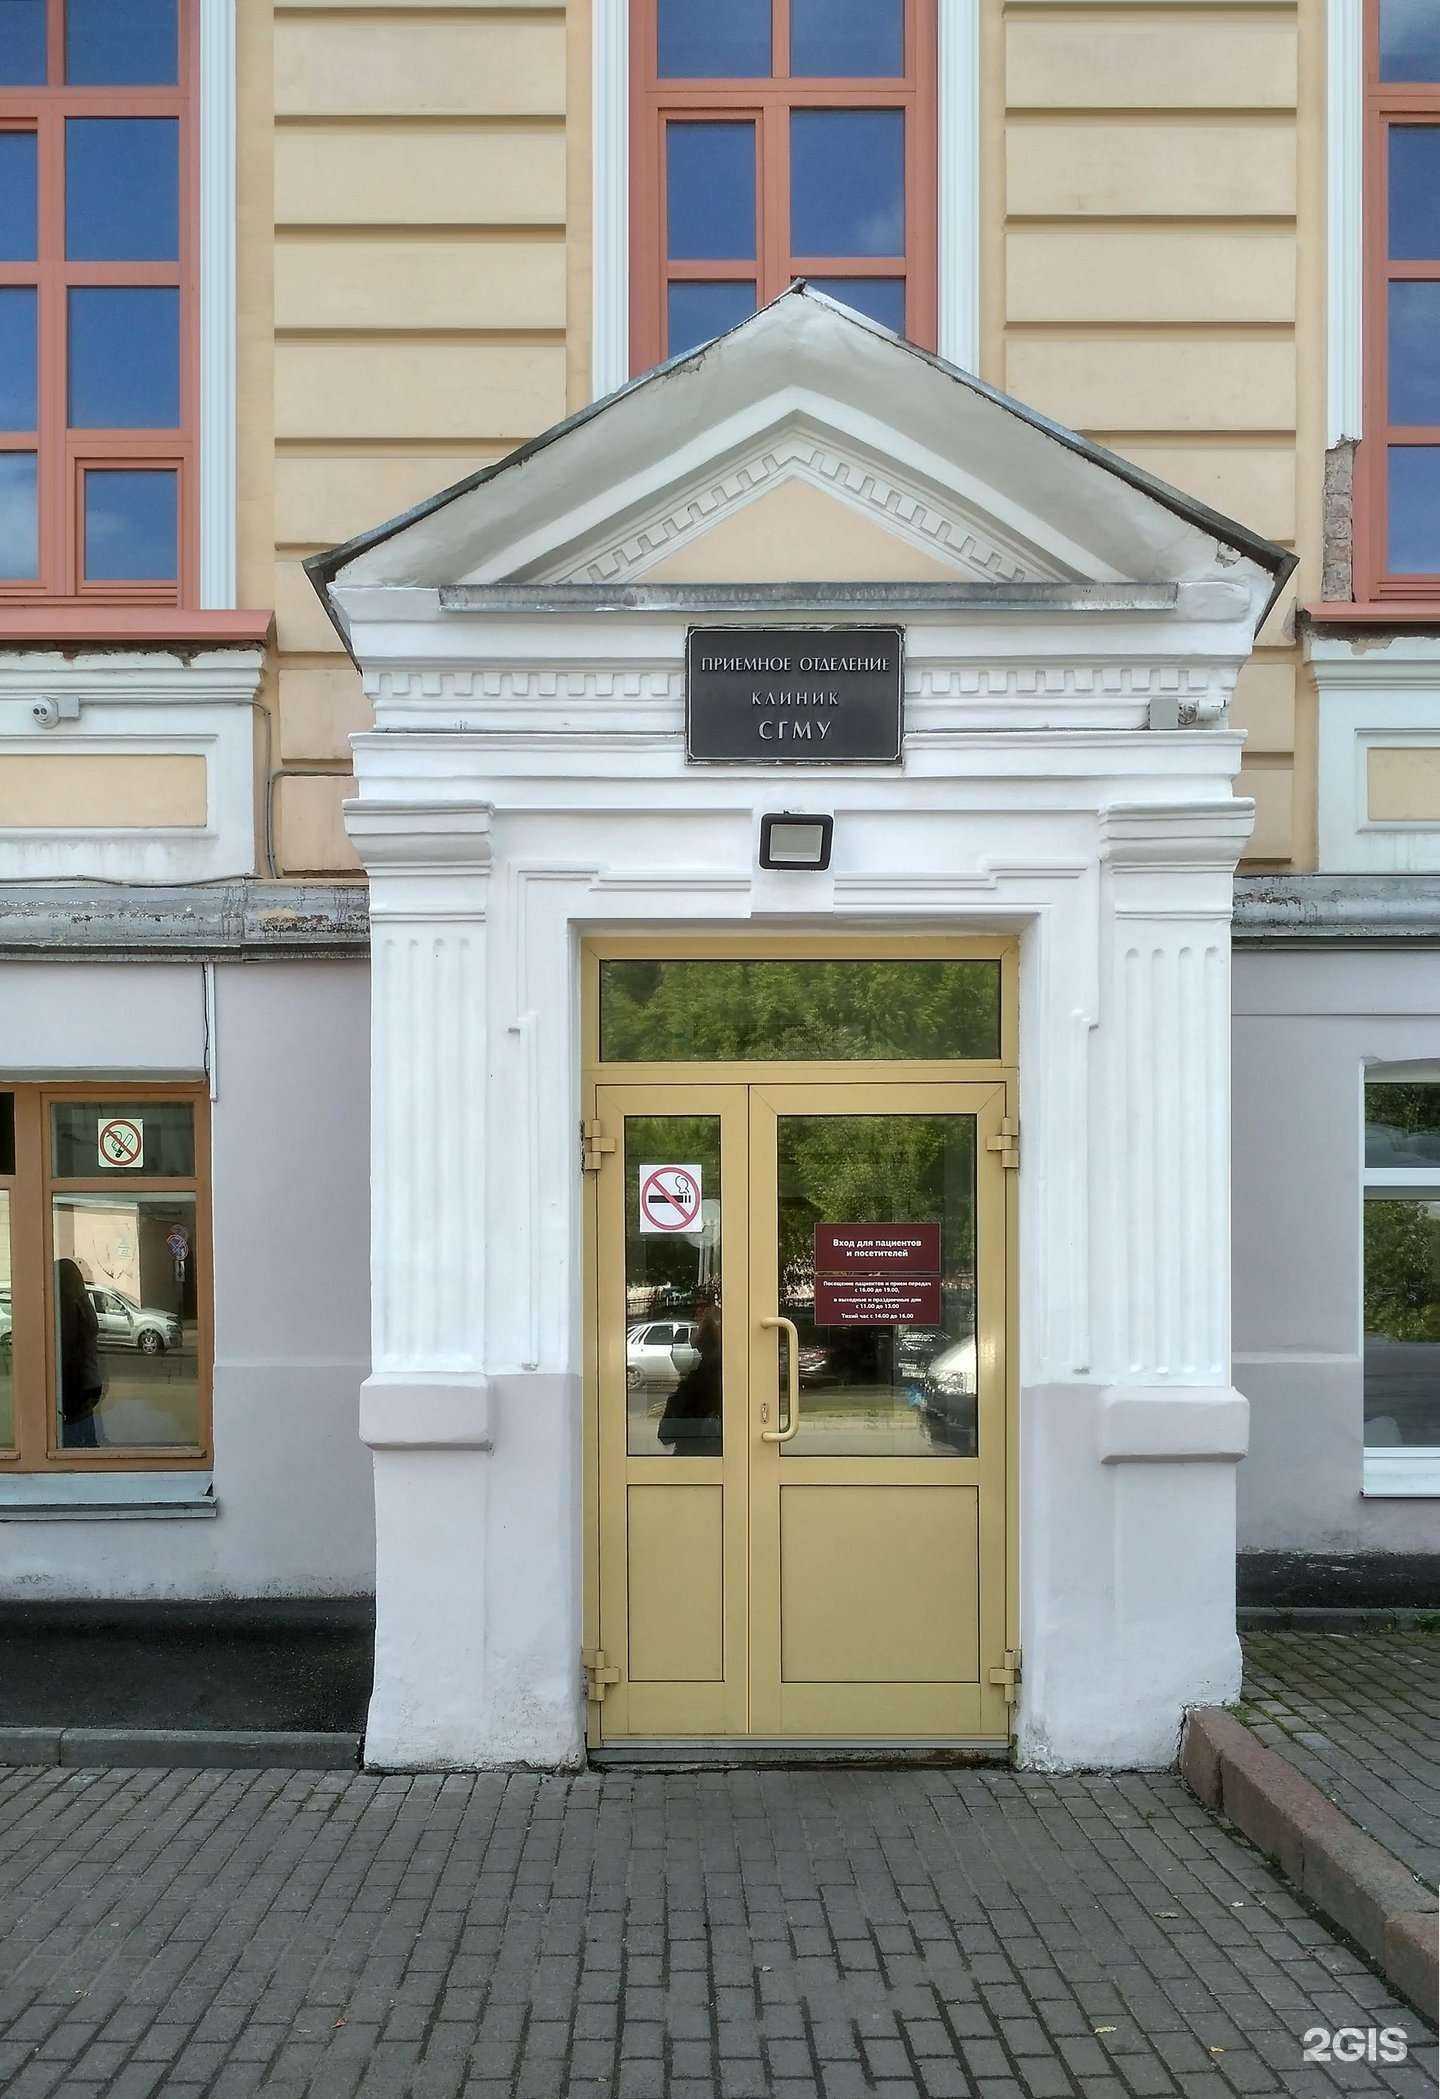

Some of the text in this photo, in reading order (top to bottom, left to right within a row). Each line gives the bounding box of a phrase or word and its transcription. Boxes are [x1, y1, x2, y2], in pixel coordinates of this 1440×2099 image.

[701, 656, 890, 672] ПРИЕМНОЕ ОТДЕЛЕНИЕ
[751, 690, 840, 706] КЛИНИК
[758, 720, 832, 740] СГМУ
[833, 1239, 922, 1248] Вход для пациентов
[854, 1249, 909, 1257] посетителей
